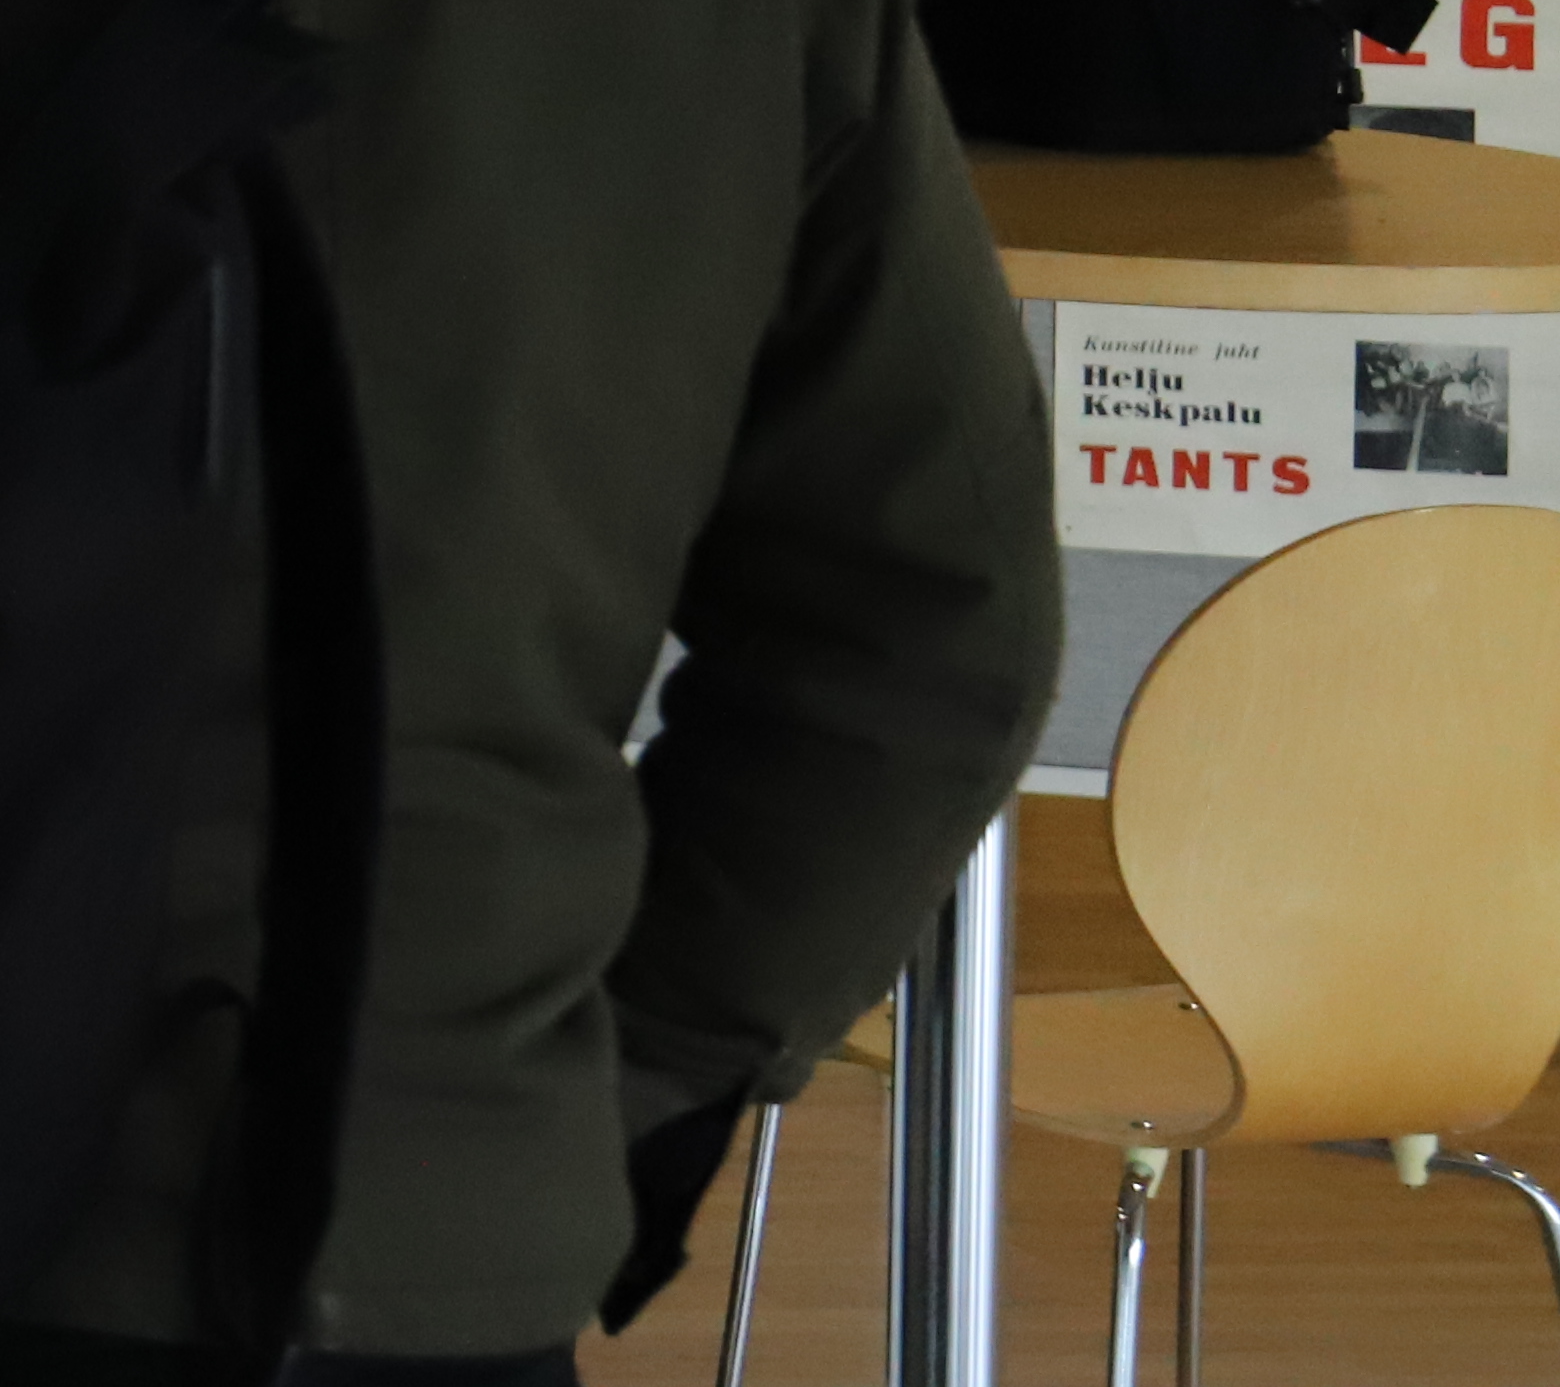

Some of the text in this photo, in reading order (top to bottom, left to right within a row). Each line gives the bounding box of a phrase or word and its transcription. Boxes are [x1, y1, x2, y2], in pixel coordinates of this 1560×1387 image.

[1083, 335, 1260, 362] Kunstiline juht
[1083, 364, 1184, 395] Helju
[1083, 393, 1263, 427] Keskpalu
[1079, 443, 1311, 495] TANTS
